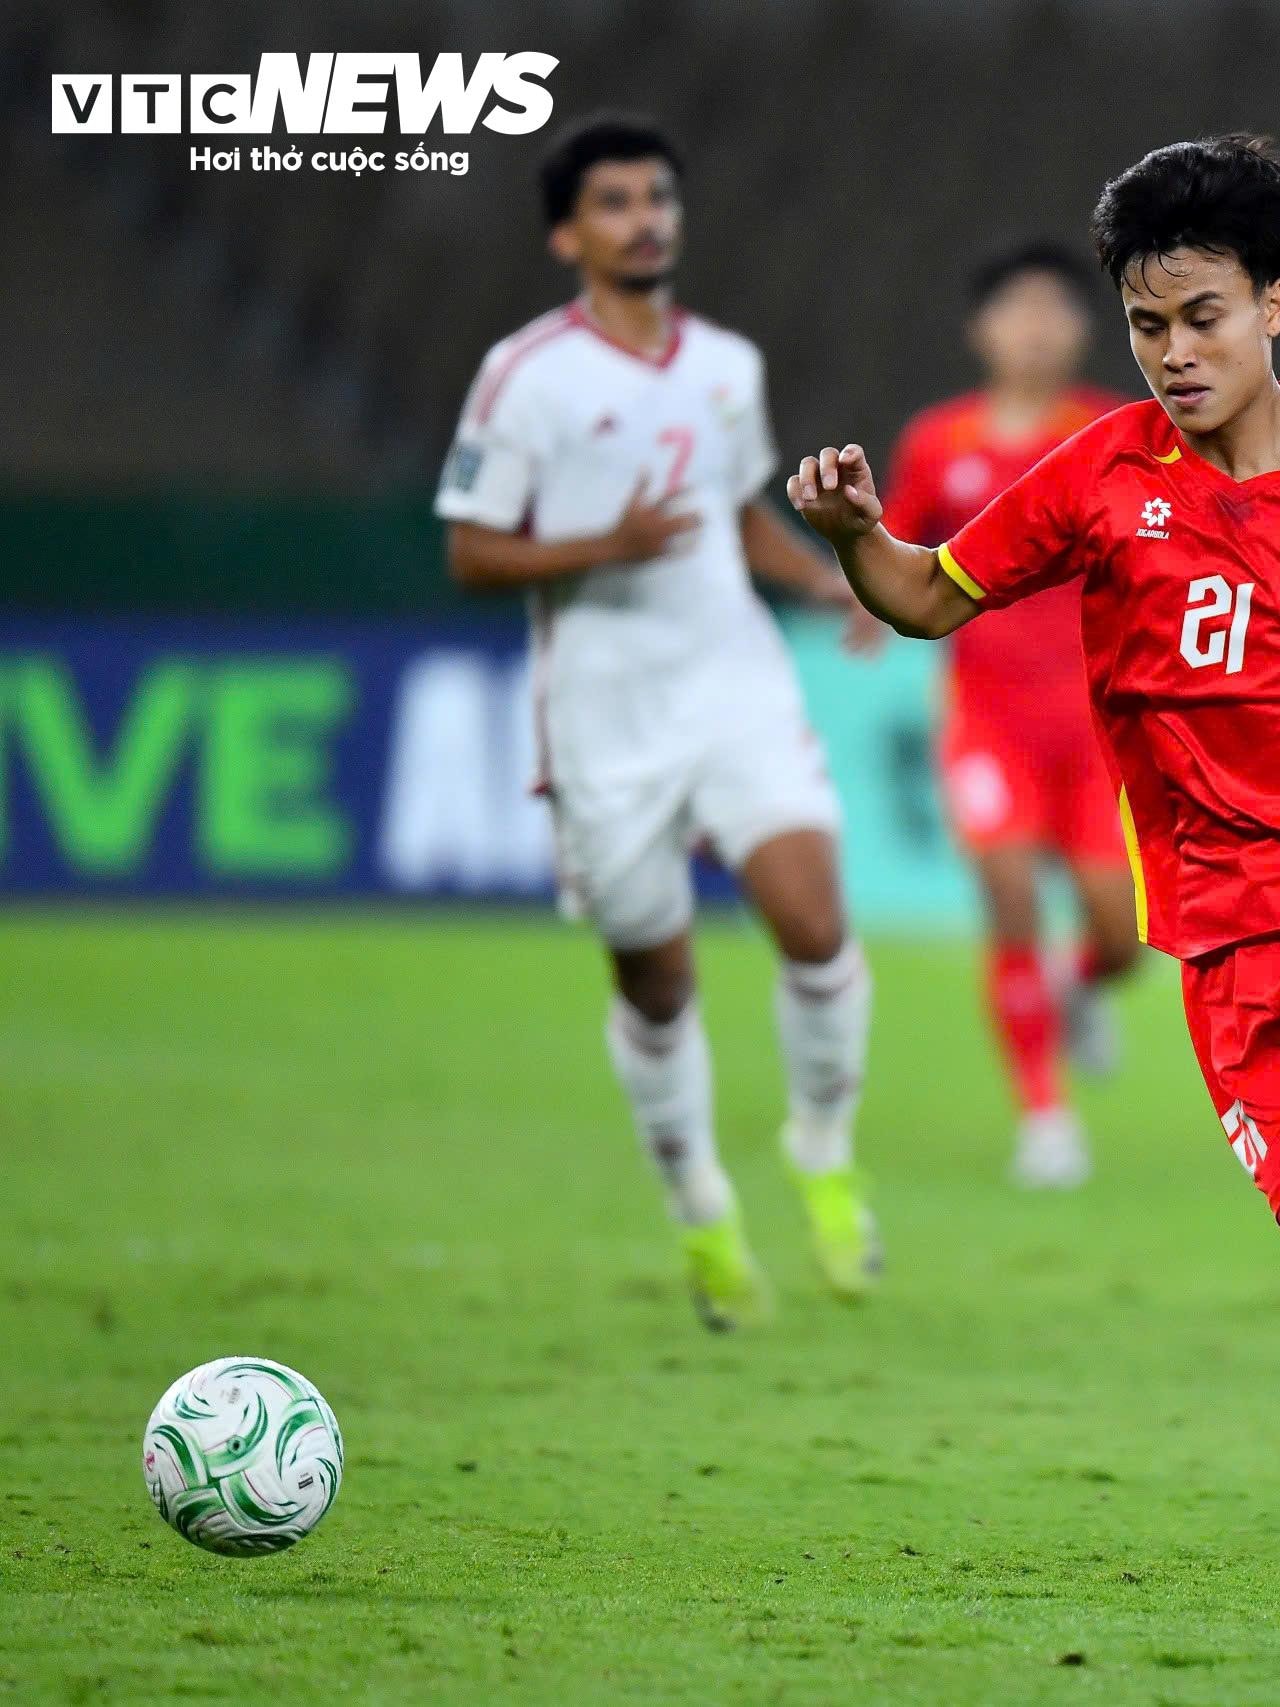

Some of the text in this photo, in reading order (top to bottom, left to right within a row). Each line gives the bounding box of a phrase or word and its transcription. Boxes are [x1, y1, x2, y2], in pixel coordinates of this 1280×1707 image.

[656, 426, 696, 498] 7
[1179, 574, 1255, 675] 21
[0, 654, 352, 874] VE
